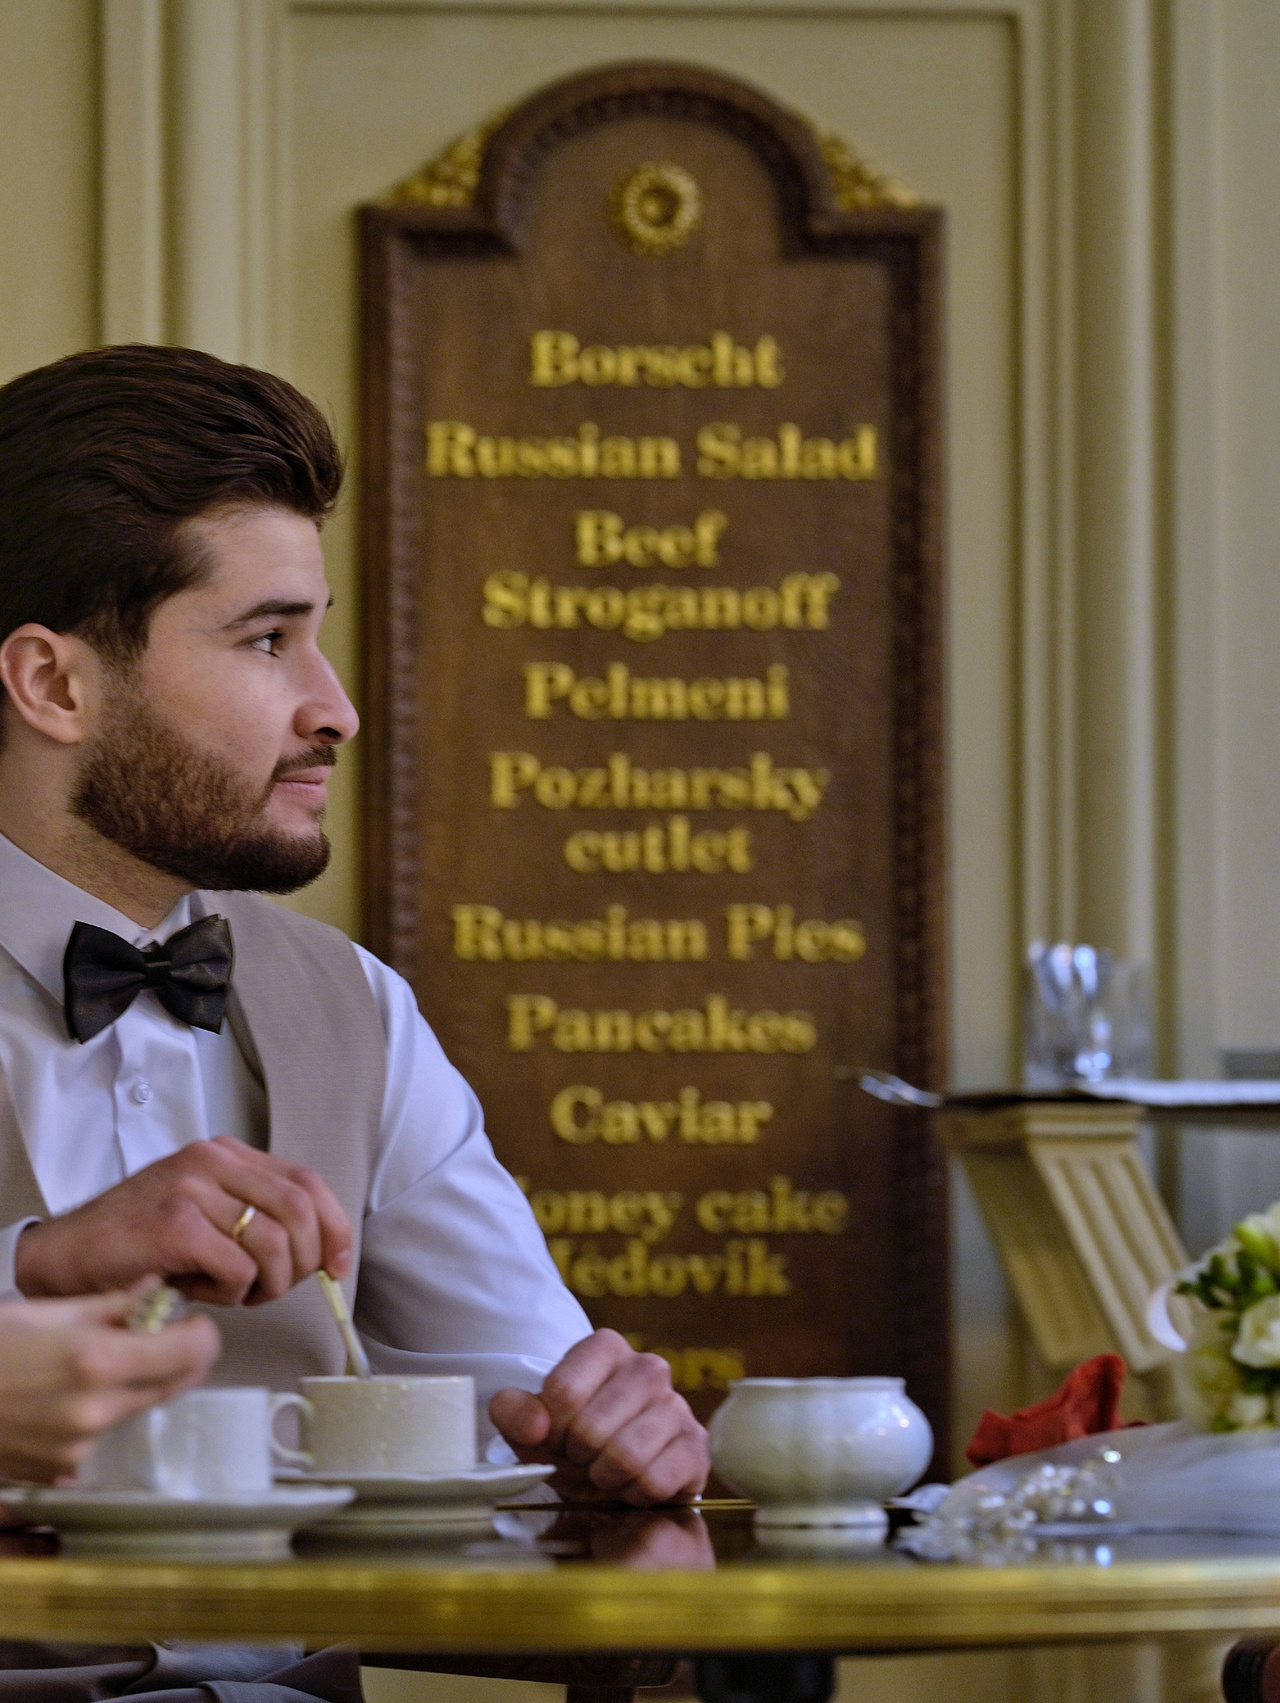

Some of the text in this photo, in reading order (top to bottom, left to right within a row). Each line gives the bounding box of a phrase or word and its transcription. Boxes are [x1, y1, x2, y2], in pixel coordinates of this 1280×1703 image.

[529, 331, 783, 388] Borscht
[426, 421, 879, 480] Russian Salad
[575, 510, 727, 568] Beef
[481, 570, 839, 641] Stroganoff
[524, 661, 789, 719] Pelmeni
[488, 751, 828, 820] Pozharsky
[564, 814, 753, 873] cutlet
[451, 904, 867, 962] Russian Pies
[507, 995, 817, 1053] Pancakes
[549, 1086, 773, 1144] Caviar
[516, 1175, 849, 1242] oney cake
